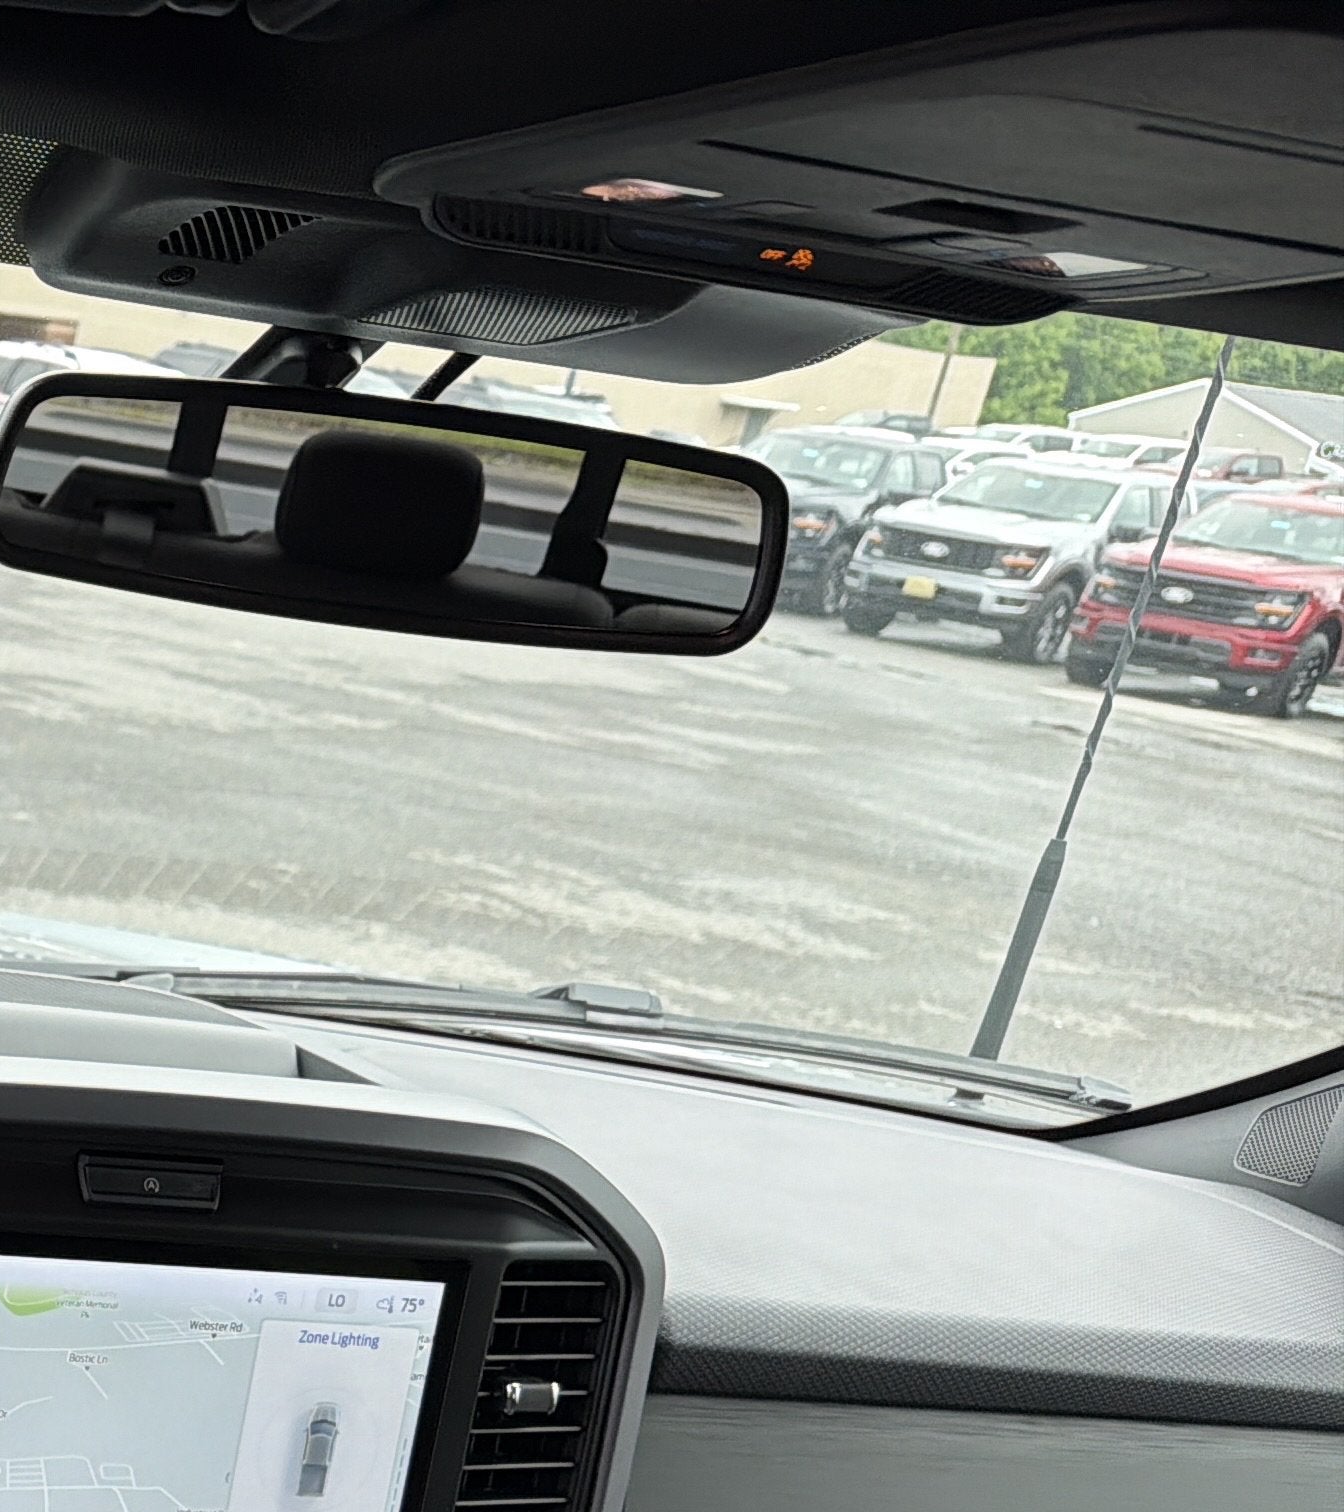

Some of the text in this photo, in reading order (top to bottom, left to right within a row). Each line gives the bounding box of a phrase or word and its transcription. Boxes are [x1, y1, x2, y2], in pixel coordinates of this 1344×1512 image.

[327, 1293, 346, 1308] LO
[400, 1298, 425, 1313] 75°
[189, 1320, 244, 1333] Webster Rd
[298, 1329, 381, 1349] Zone Lighting
[68, 1352, 108, 1364] Bostic Ln
